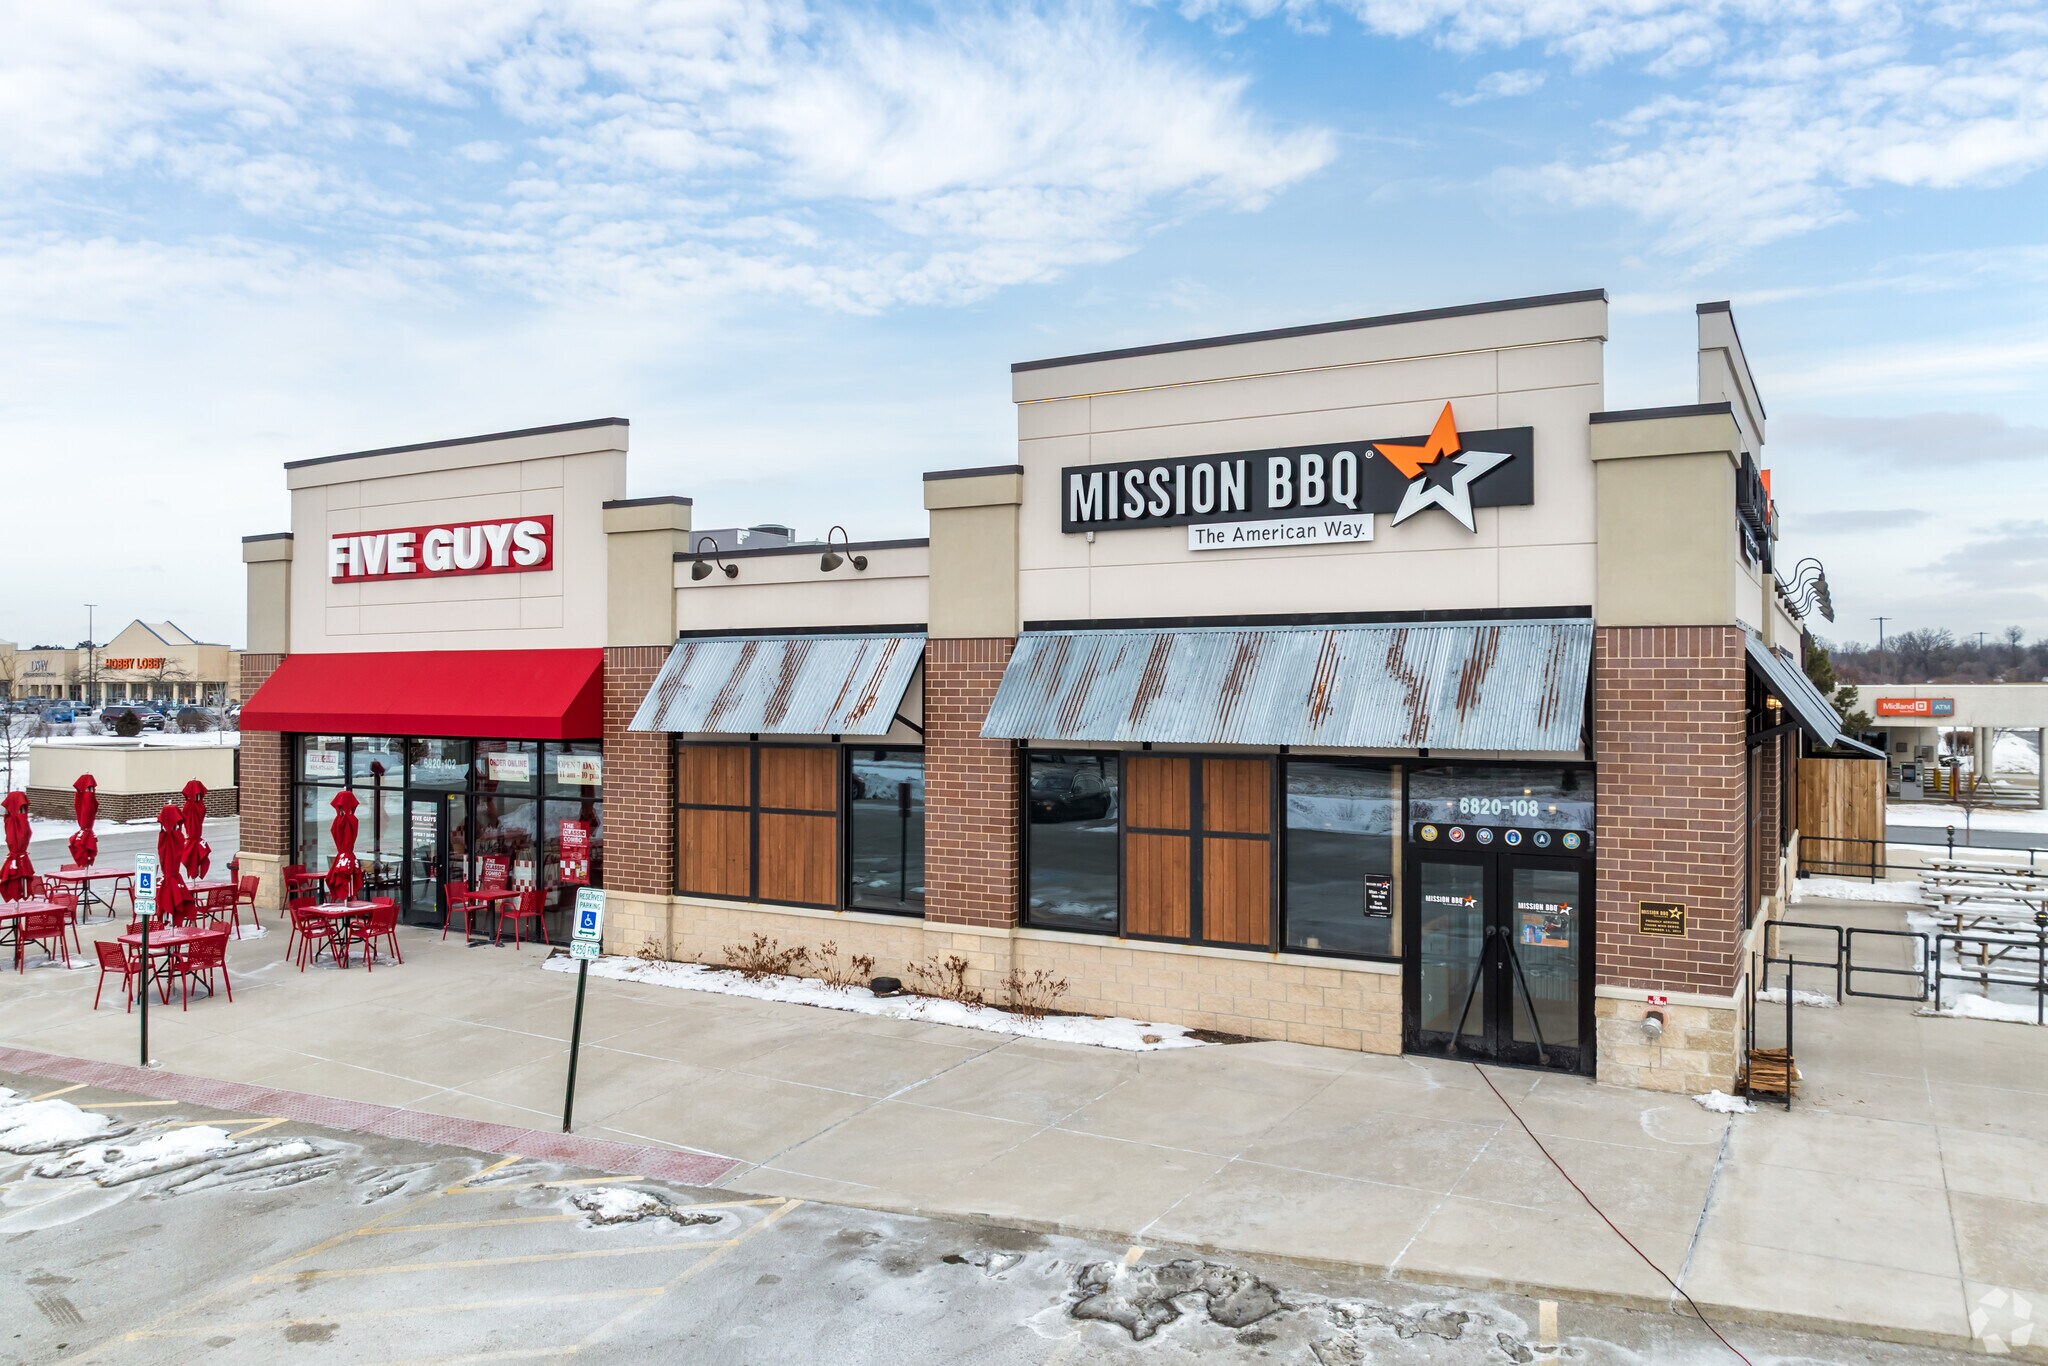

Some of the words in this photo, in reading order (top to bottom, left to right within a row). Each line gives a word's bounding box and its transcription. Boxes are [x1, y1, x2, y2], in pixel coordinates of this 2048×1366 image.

[1069, 459, 1251, 523] MISSION
[1267, 450, 1358, 510] BBQ
[1196, 528, 1225, 544] The
[1232, 523, 1318, 542] American
[1324, 520, 1365, 539] Way.
[329, 532, 416, 577] FIVE
[422, 520, 547, 571] GUYS
[105, 658, 134, 669] HOBBY
[137, 657, 166, 669] LOBBY
[490, 759, 506, 767] ORDER
[508, 759, 527, 768] ONLINE
[558, 761, 576, 769] OPEN
[582, 762, 600, 770] DAYS
[1459, 797, 1539, 817] 6820-108
[579, 892, 603, 901] RESERVED
[1425, 895, 1450, 904] MISSION
[1451, 896, 1463, 904] BBQ
[579, 902, 601, 910] PARKING
[1518, 902, 1544, 911] MISSION
[1545, 904, 1558, 912] BBQ
[588, 945, 598, 956] FINE
